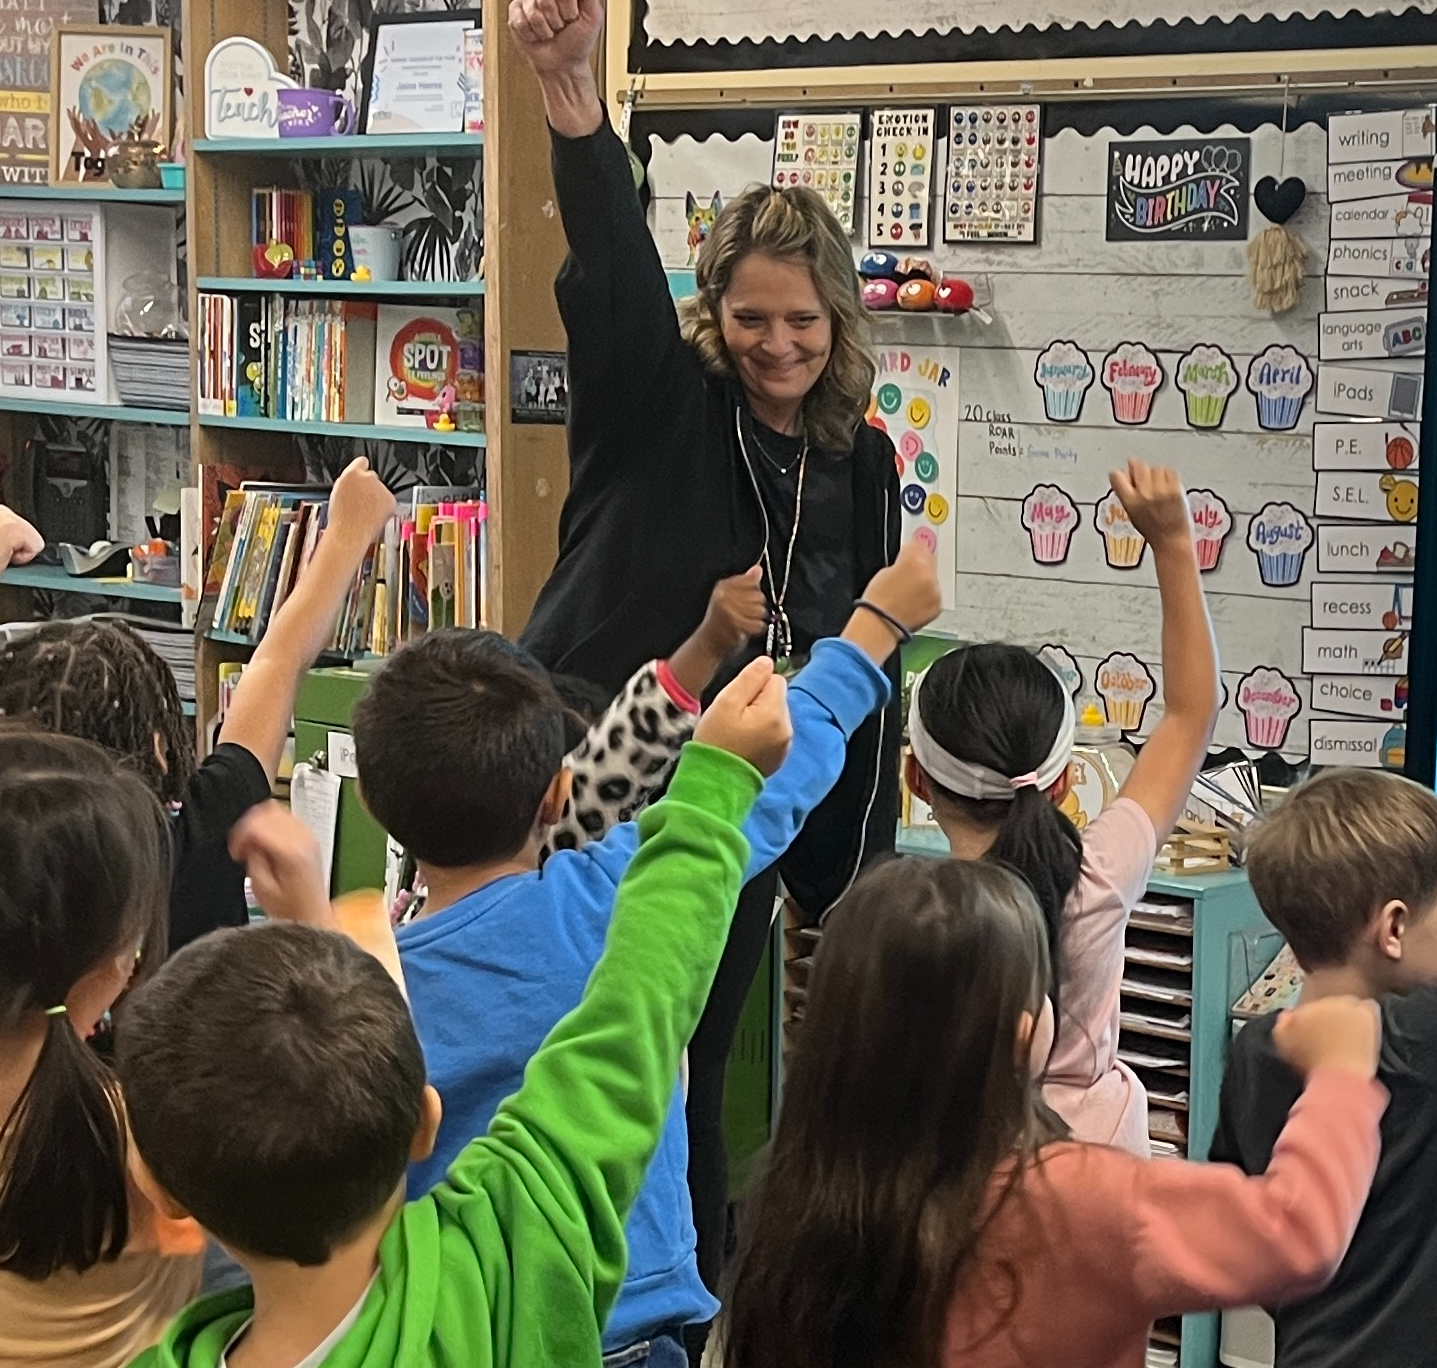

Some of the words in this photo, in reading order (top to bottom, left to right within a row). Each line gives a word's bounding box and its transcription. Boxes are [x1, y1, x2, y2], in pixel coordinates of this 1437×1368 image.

[210, 88, 280, 128] Teach
[878, 113, 928, 125] EMOTION
[1339, 129, 1390, 148] writing
[881, 143, 887, 157] 1
[1, 165, 49, 184] WIT
[880, 162, 888, 176] 2
[1125, 150, 1200, 188] HAPPY
[1333, 164, 1392, 183] meeting
[879, 181, 886, 195] 3
[877, 203, 885, 217] 4
[1135, 180, 1220, 227] BIRTHDAY
[1335, 208, 1389, 221] calendar
[877, 223, 884, 237] 5
[1332, 244, 1388, 261] phonics
[1333, 279, 1379, 300] snack
[1322, 322, 1382, 338] language
[1392, 326, 1423, 348] ABC
[1341, 339, 1363, 351] arts
[403, 342, 452, 370] SPOT
[880, 351, 911, 374] ARD
[917, 358, 951, 388] JAR
[1040, 362, 1089, 381] January
[1109, 359, 1157, 387] February
[1183, 361, 1230, 387] March
[1259, 362, 1302, 385] April
[1333, 382, 1374, 401] iPads
[964, 404, 983, 422] 20
[986, 410, 1012, 423] Class
[988, 424, 1015, 439] ROAR
[989, 441, 1017, 456] Points
[1335, 439, 1362, 455] P.E.
[1332, 486, 1369, 504] S.E.L.
[1031, 502, 1071, 523] May
[1193, 504, 1223, 528] uly
[1255, 520, 1304, 545] August
[1327, 541, 1370, 557] lunch
[1323, 602, 1372, 615] recess
[1317, 645, 1358, 659] math
[1320, 681, 1373, 701] choice
[1313, 736, 1378, 753] dismissal
